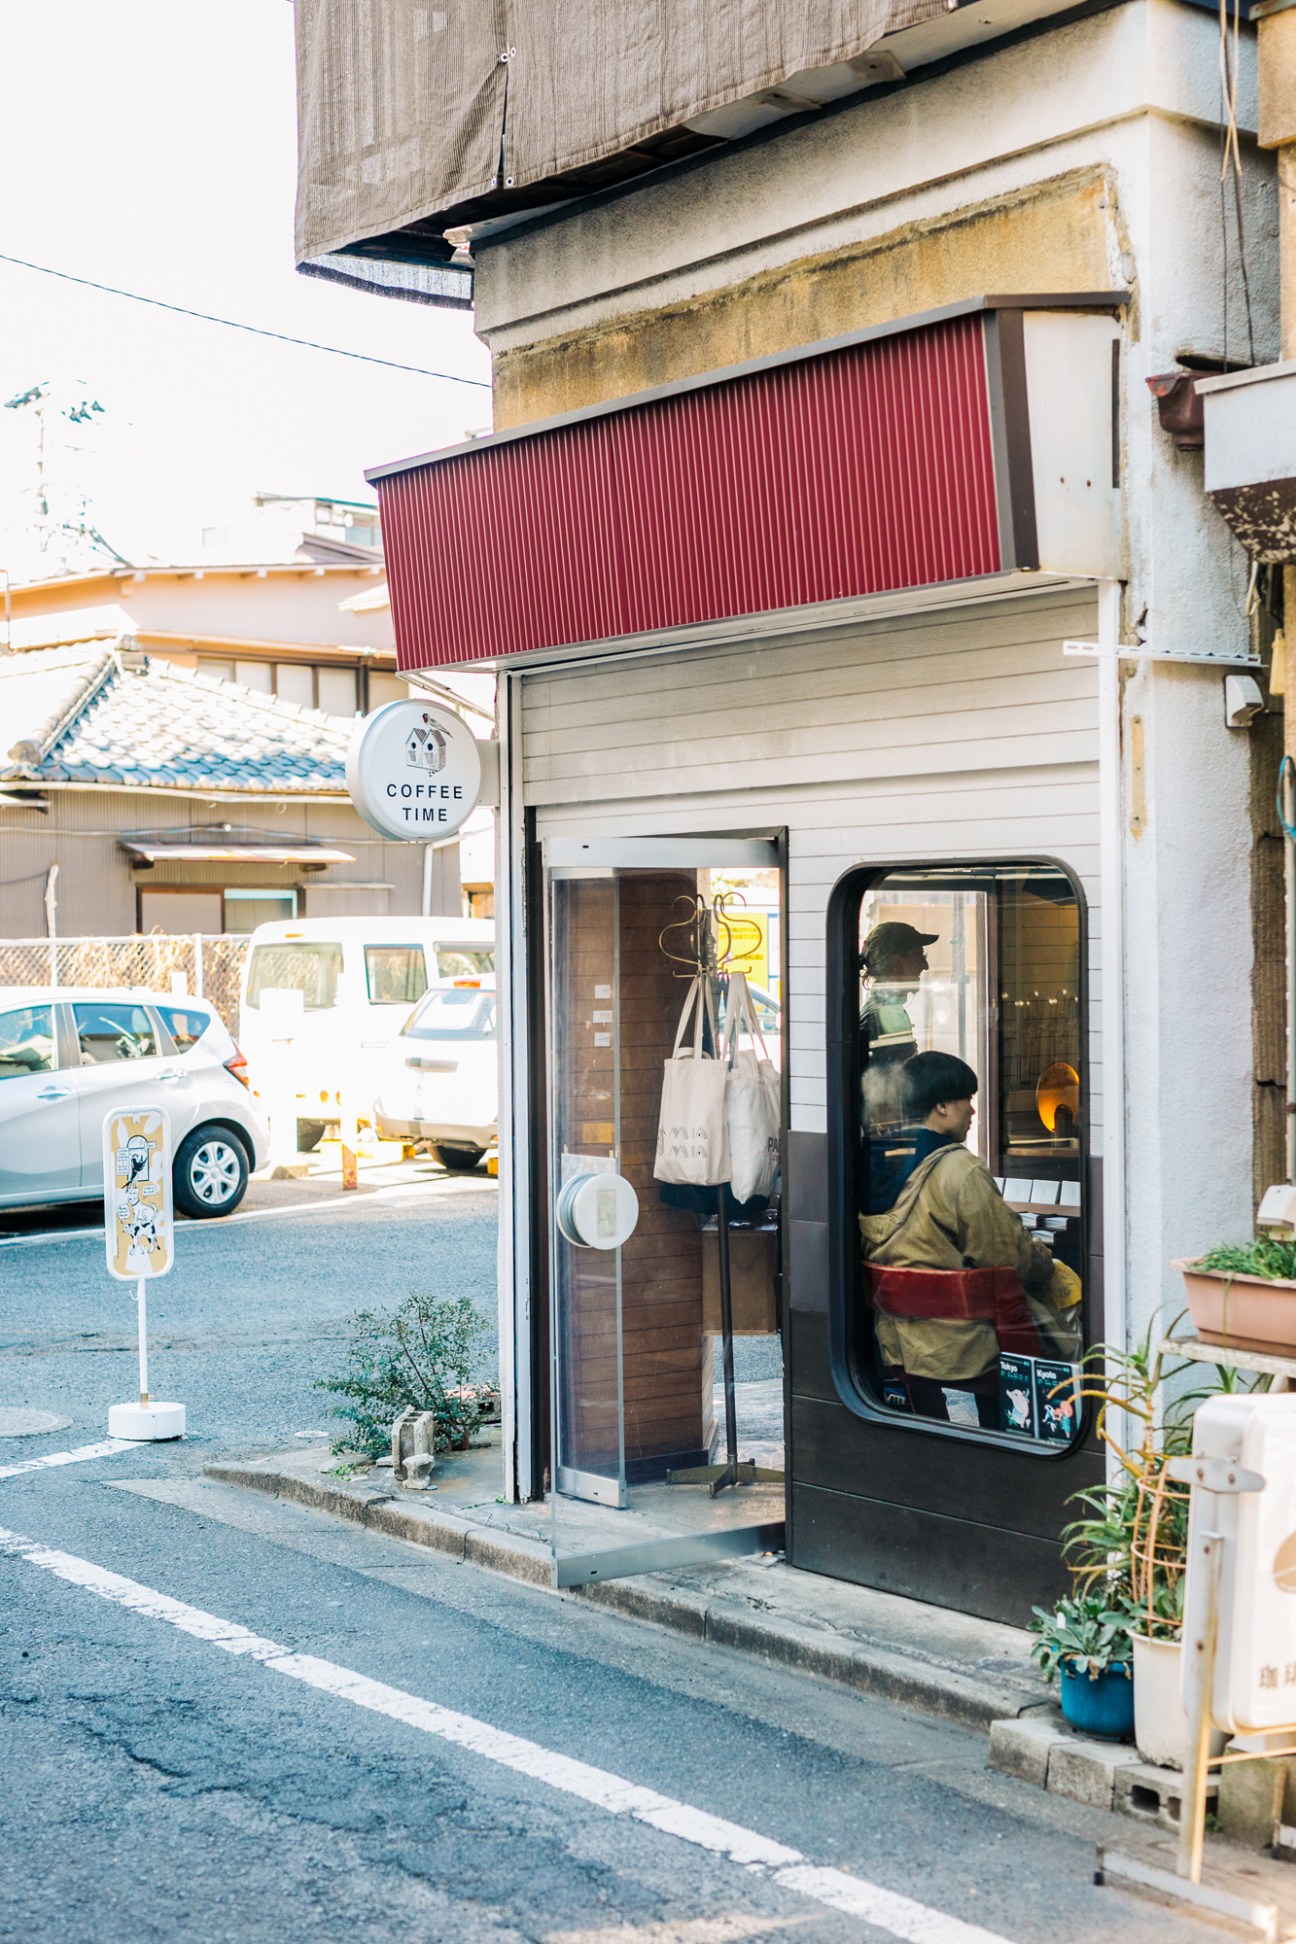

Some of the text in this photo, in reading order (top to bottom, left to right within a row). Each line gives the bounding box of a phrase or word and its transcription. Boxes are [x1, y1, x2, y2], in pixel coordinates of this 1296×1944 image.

[386, 783, 463, 799] COFFEE
[402, 807, 448, 822] TIME
[1000, 1361, 1018, 1373] Tokyo
[1036, 1369, 1057, 1380] Kyoto
